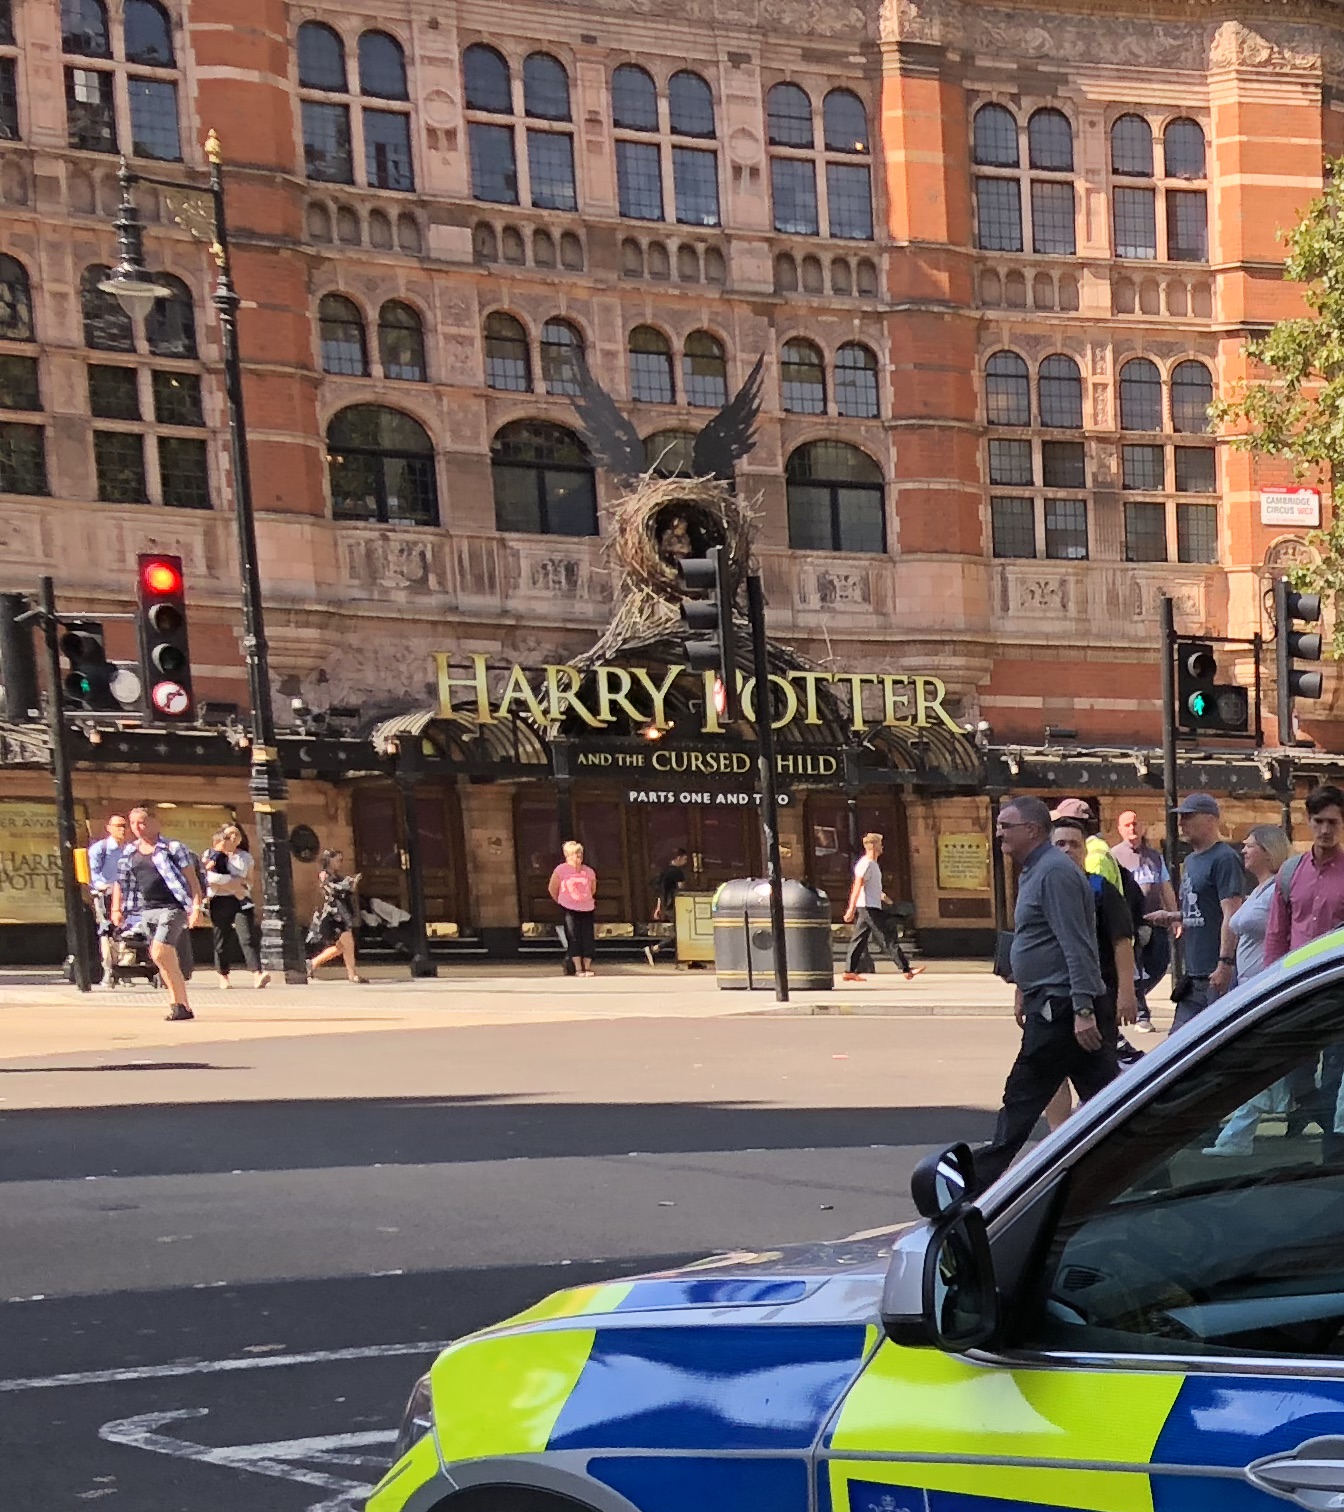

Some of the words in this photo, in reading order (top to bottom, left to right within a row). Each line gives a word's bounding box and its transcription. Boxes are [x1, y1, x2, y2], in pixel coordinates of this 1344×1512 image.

[1265, 496, 1311, 506] CAMBRIDGE
[1266, 505, 1295, 515] CIRCUS
[1297, 507, 1314, 516] WC2
[433, 650, 686, 730] HARRY
[577, 753, 613, 768] AND
[616, 754, 646, 768] THE
[651, 749, 752, 775] CURSED
[758, 753, 838, 775] HILD
[629, 790, 676, 805] PARTS
[679, 791, 712, 805] ONE
[716, 792, 749, 806] AND
[752, 792, 789, 806] TO
